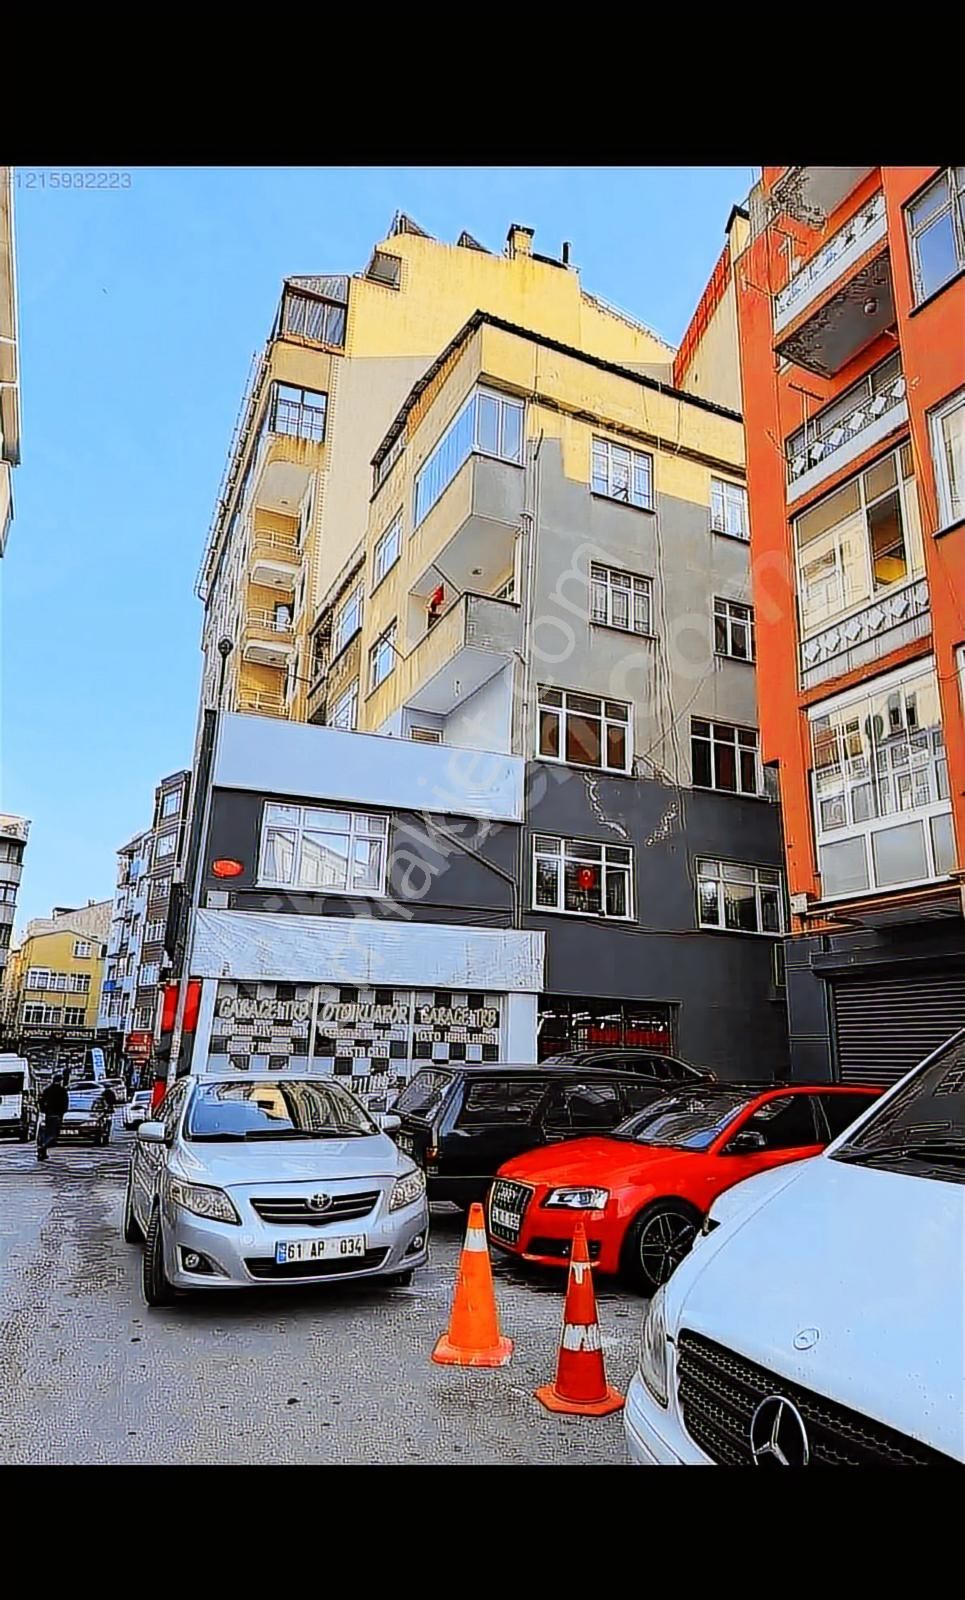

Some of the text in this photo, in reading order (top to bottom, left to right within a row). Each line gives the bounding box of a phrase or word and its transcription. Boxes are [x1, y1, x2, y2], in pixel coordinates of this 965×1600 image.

[287, 1243, 302, 1259] 61
[310, 1241, 325, 1257] AP
[340, 1239, 362, 1254] 034
